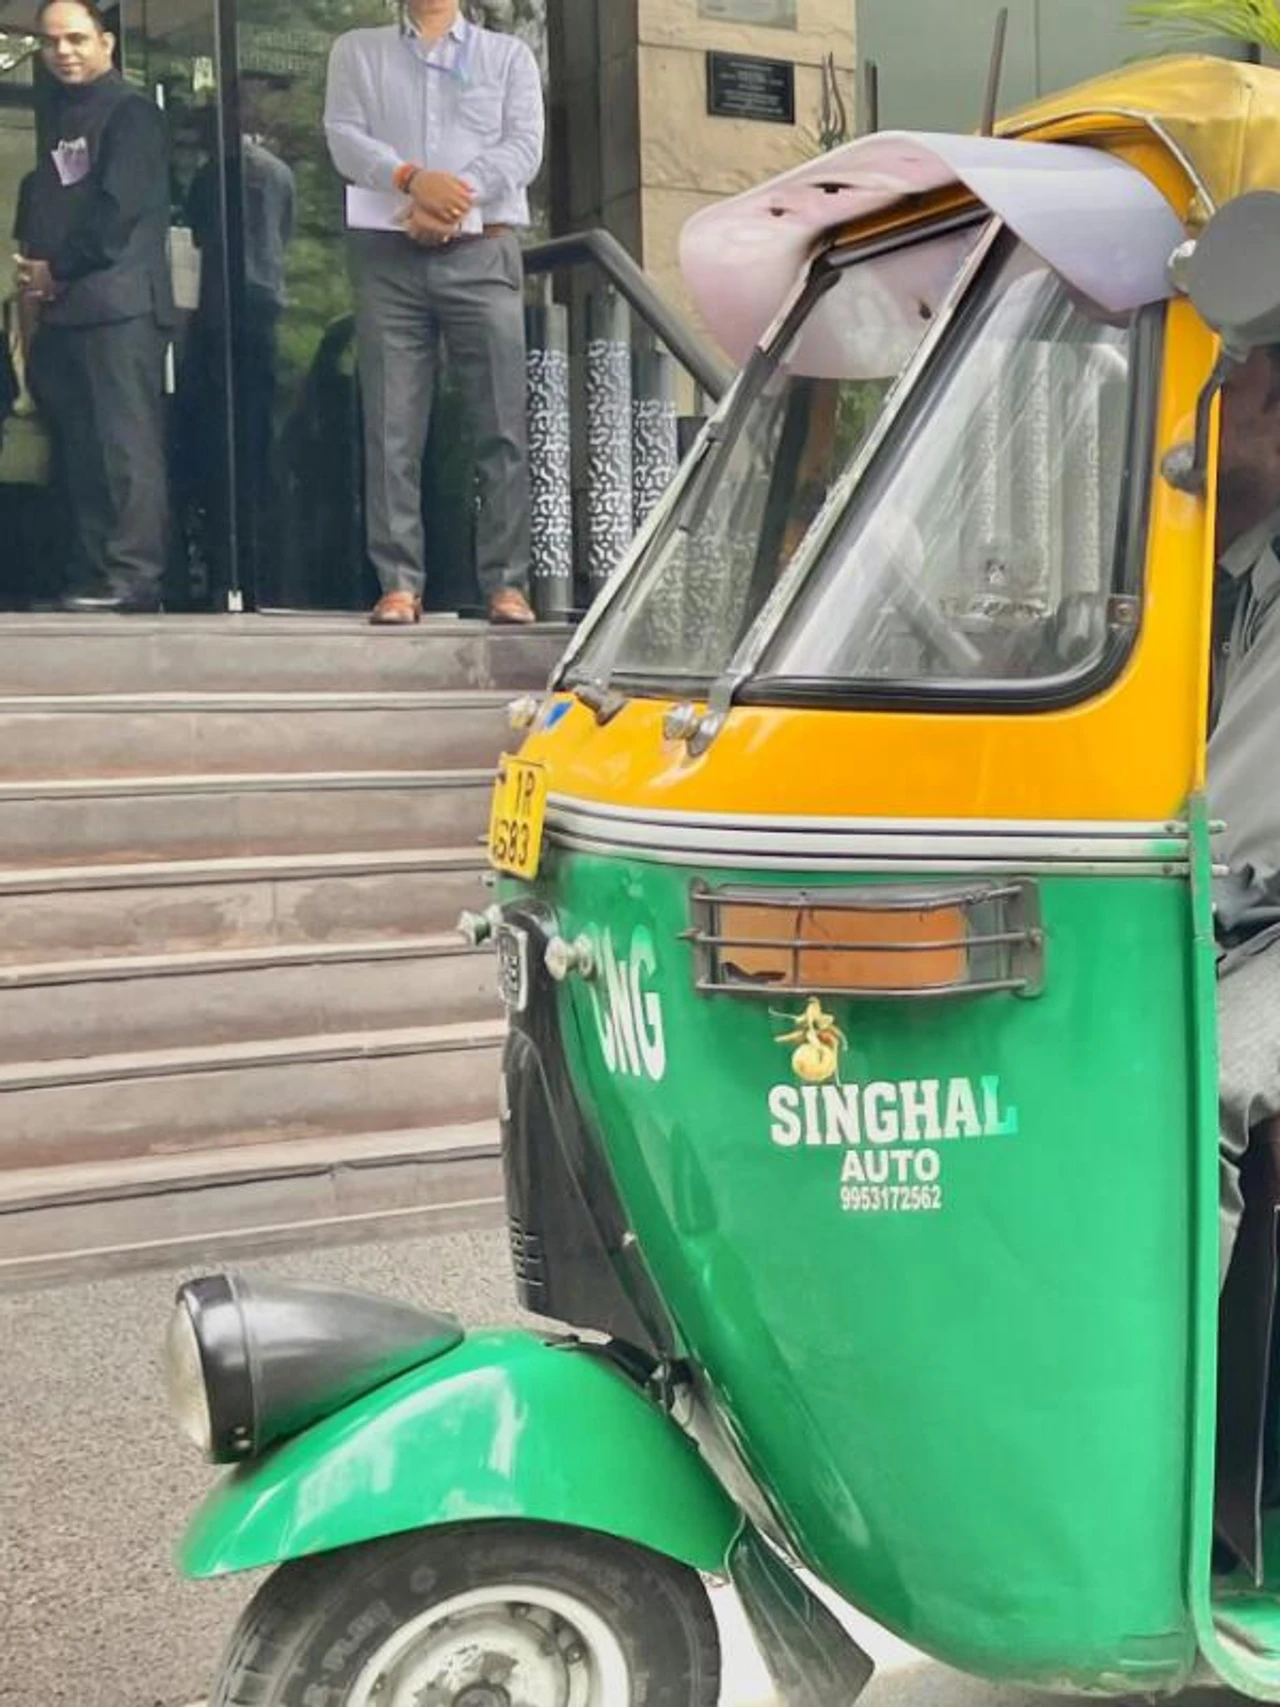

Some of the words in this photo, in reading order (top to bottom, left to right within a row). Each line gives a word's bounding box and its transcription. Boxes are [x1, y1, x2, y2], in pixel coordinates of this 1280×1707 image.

[583, 921, 666, 1082] CNG
[768, 1075, 1019, 1147] SINGHAL
[840, 1148, 941, 1183] AUTO
[840, 1185, 943, 1212] 9953172562
